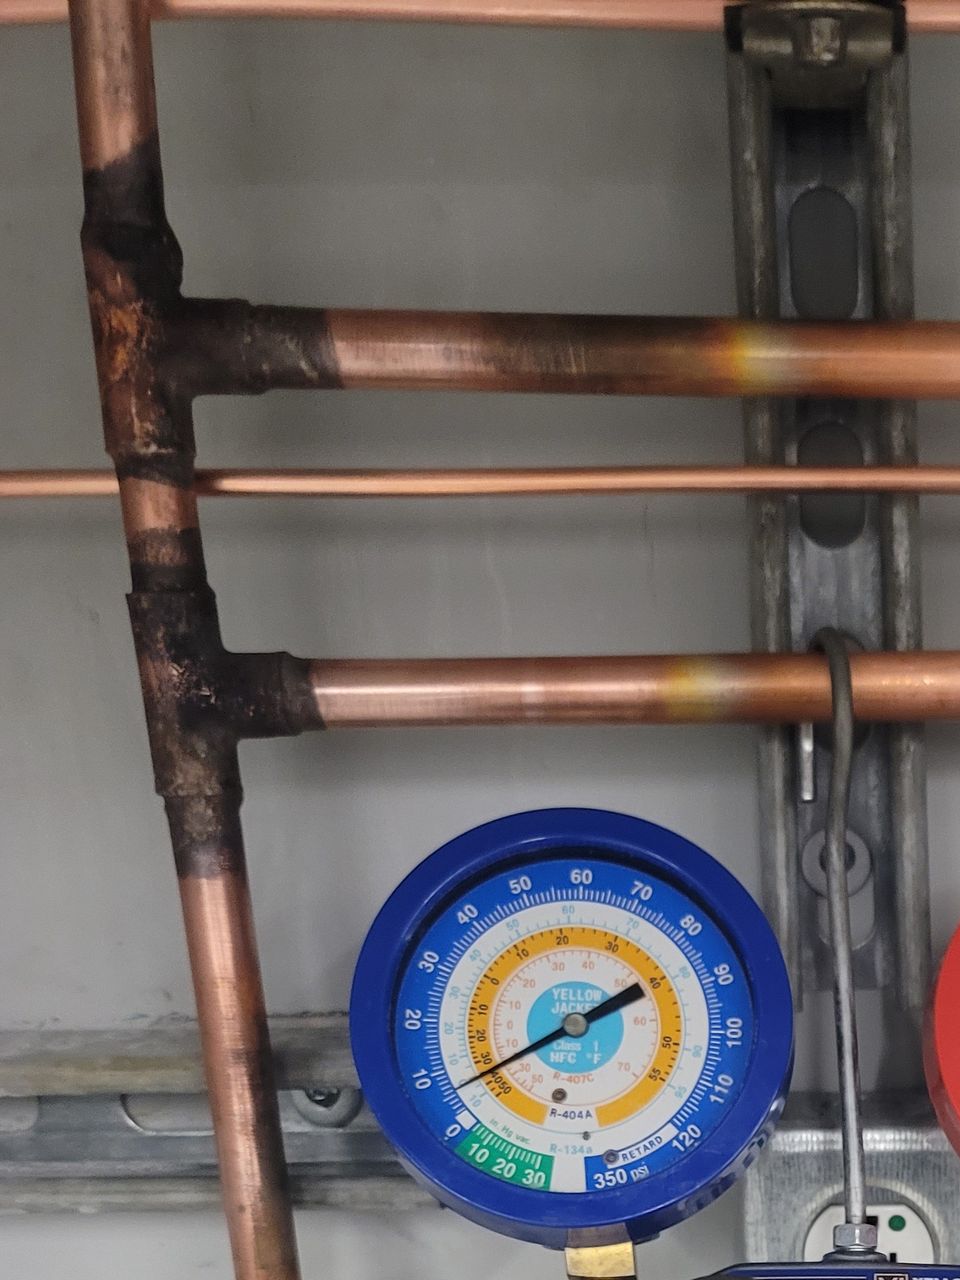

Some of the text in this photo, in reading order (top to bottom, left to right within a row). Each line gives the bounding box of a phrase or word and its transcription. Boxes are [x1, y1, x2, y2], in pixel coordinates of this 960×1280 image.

[570, 869, 592, 884] 60
[509, 876, 532, 894] 50
[630, 881, 653, 900] 70
[456, 904, 478, 924] 40
[680, 915, 702, 936] 80
[556, 936, 569, 946] 20
[605, 941, 619, 953] 30
[418, 951, 440, 973] 30
[517, 949, 529, 960] 10
[490, 978, 500, 986] 0
[714, 964, 734, 985] 90
[650, 977, 661, 990] 40
[552, 988, 602, 1000] YELLOW
[479, 1004, 488, 1016] 10
[404, 1009, 421, 1030] 20
[476, 1029, 487, 1042] 20
[726, 1017, 743, 1048] 100
[662, 1036, 672, 1049] 50
[481, 1051, 492, 1065] 30
[412, 1068, 432, 1090] 10
[649, 1068, 661, 1082] 55
[710, 1074, 734, 1104] 110
[550, 1108, 593, 1119] R-404A
[445, 1123, 462, 1138] 0
[672, 1124, 701, 1152] 120
[468, 1143, 490, 1163] 10
[622, 1136, 663, 1162] RETARD
[492, 1158, 516, 1178] 20
[522, 1172, 546, 1187] 30
[593, 1164, 649, 1189] 350 psi
